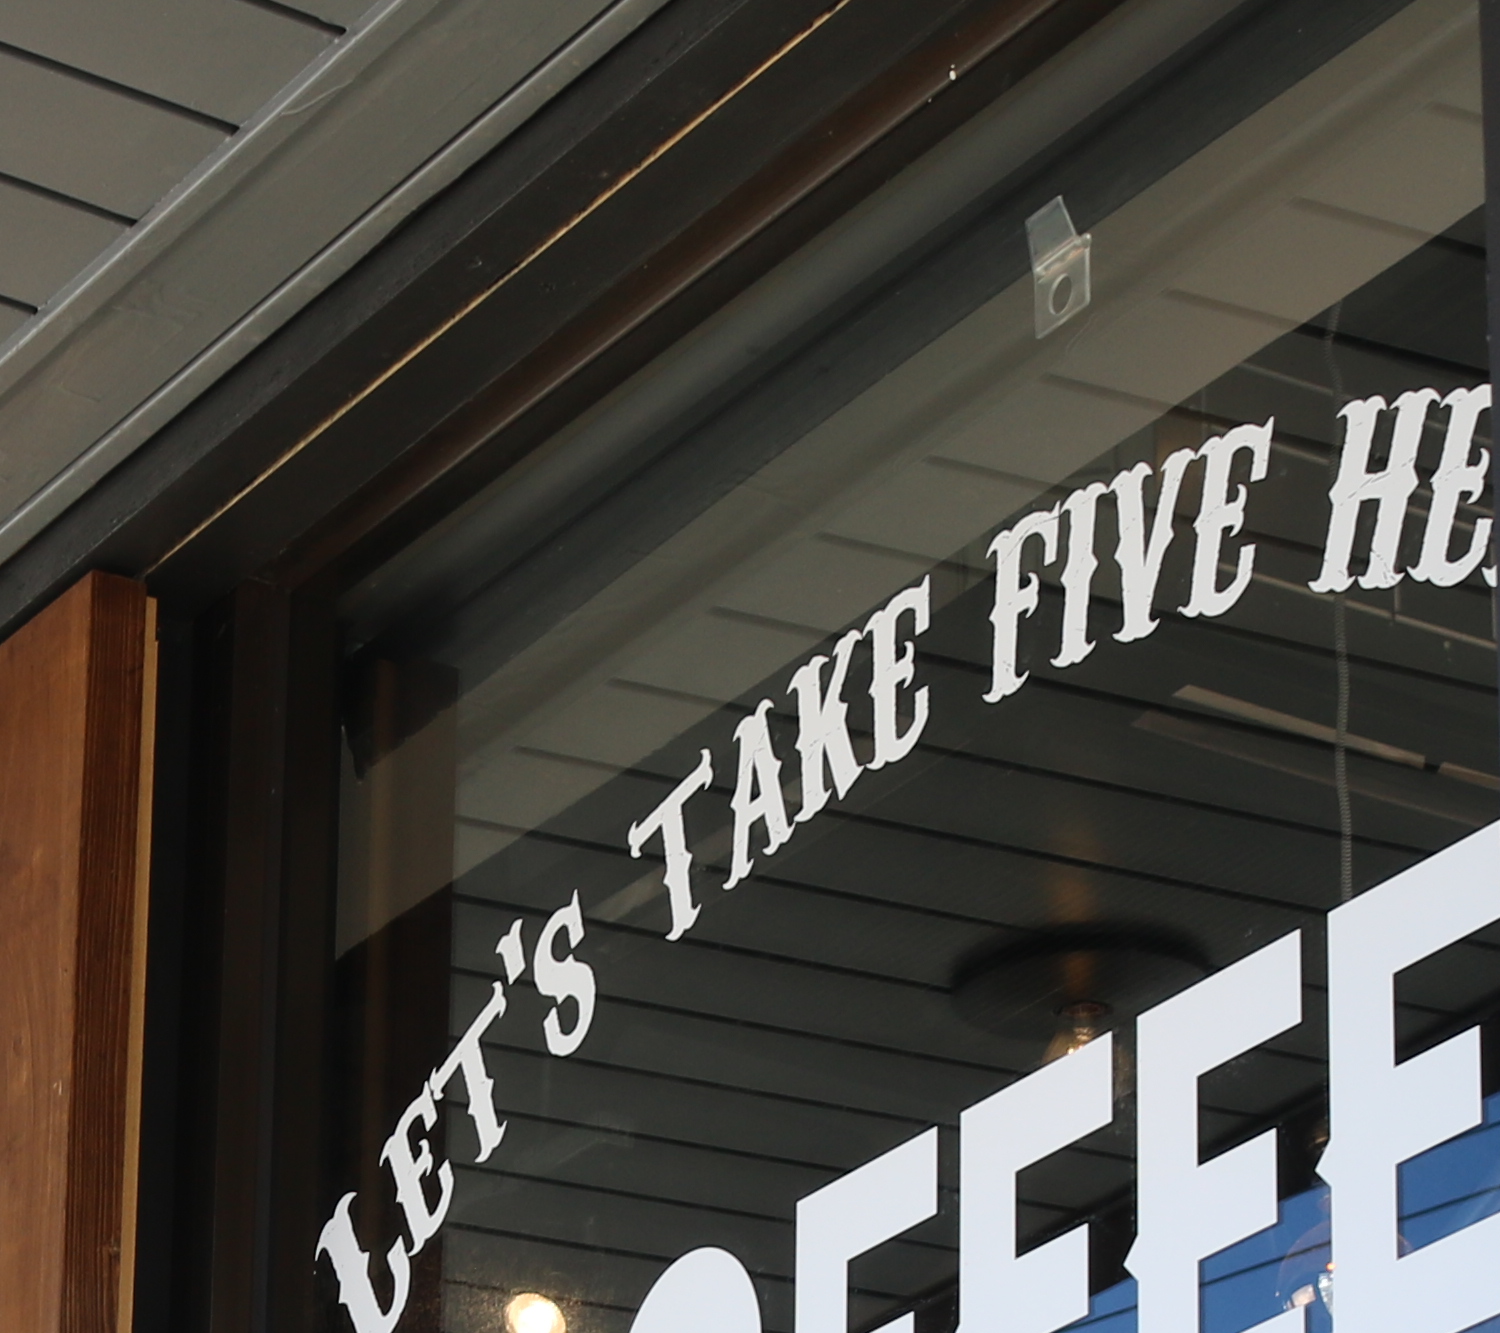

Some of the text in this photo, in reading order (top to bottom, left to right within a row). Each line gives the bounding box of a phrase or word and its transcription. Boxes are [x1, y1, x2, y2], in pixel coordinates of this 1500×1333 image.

[626, 575, 932, 942] TAKE
[981, 416, 1276, 705] FIVE
[1308, 383, 1498, 593] HE
